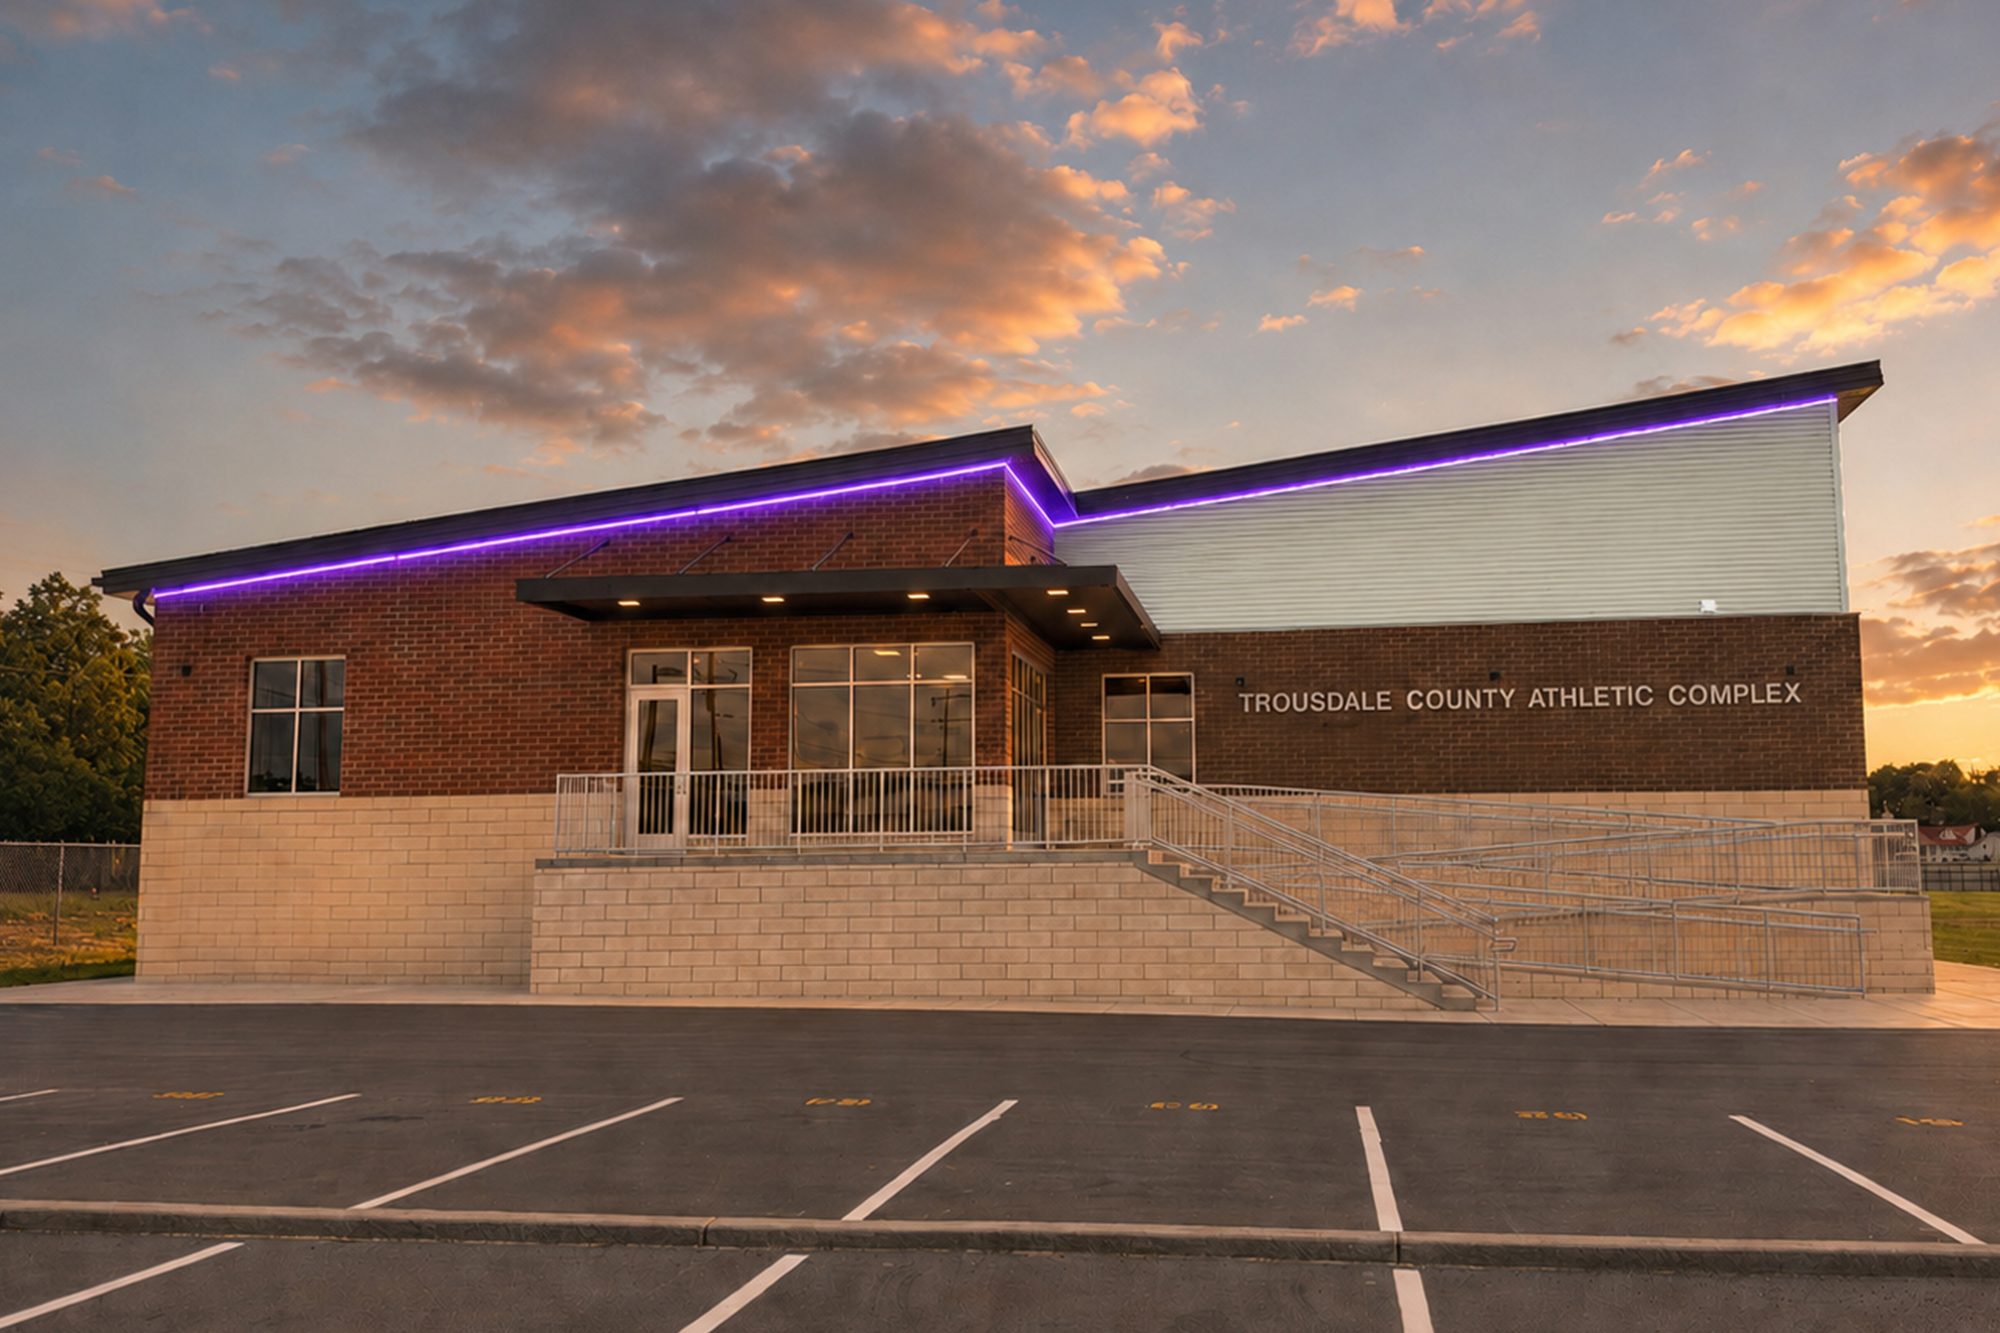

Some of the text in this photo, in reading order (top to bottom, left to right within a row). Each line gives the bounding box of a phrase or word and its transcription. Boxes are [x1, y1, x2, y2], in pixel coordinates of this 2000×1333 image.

[1238, 682, 1802, 713] TROUSDALE COUNTY ATHLETIC COMPLEX
